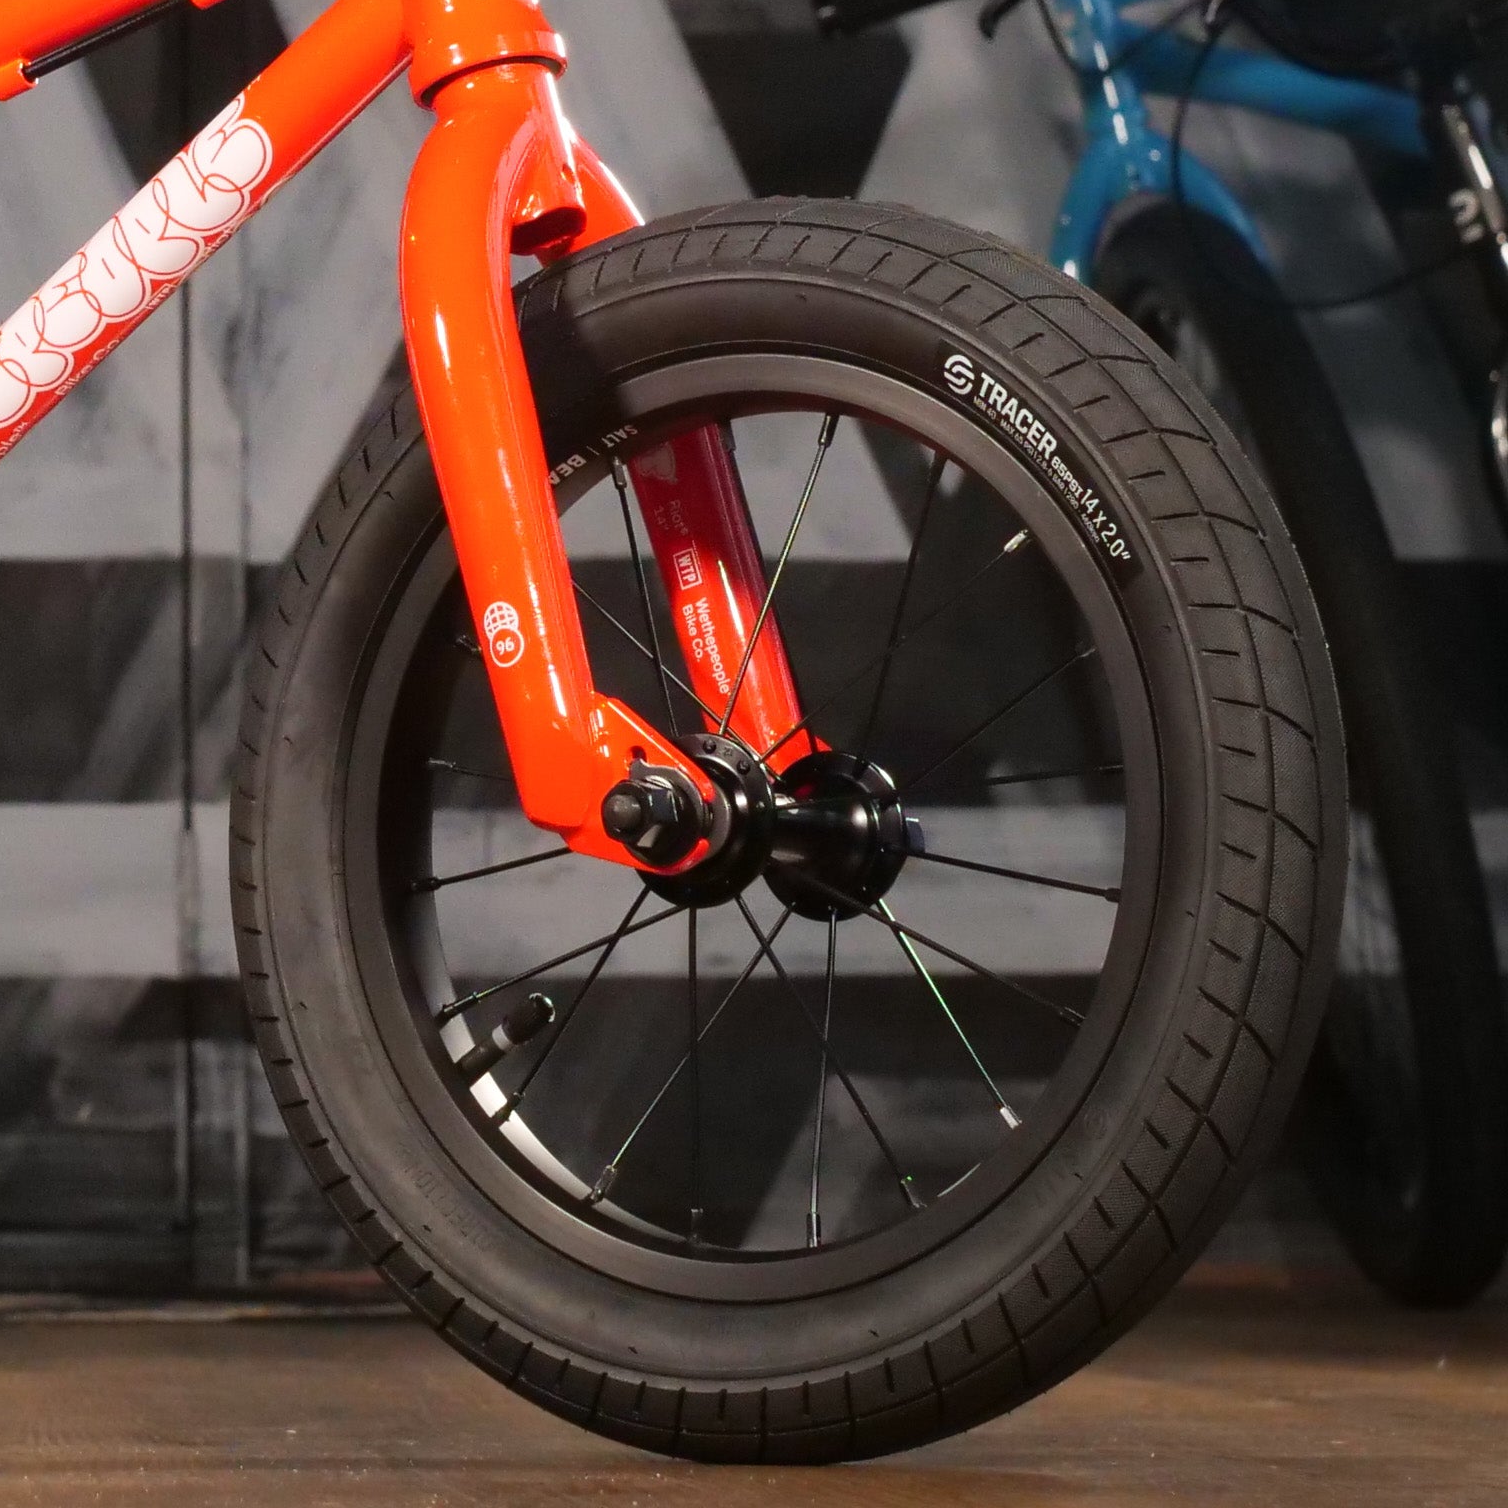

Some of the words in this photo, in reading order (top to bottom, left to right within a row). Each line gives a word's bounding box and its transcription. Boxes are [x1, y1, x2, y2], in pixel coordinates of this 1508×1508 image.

[979, 372, 1058, 460] TRACER
[601, 424, 638, 448] SALT
[547, 454, 587, 485] BEA
[496, 636, 515, 656] 96
[682, 603, 698, 637] Bike
[691, 638, 705, 663] Co.
